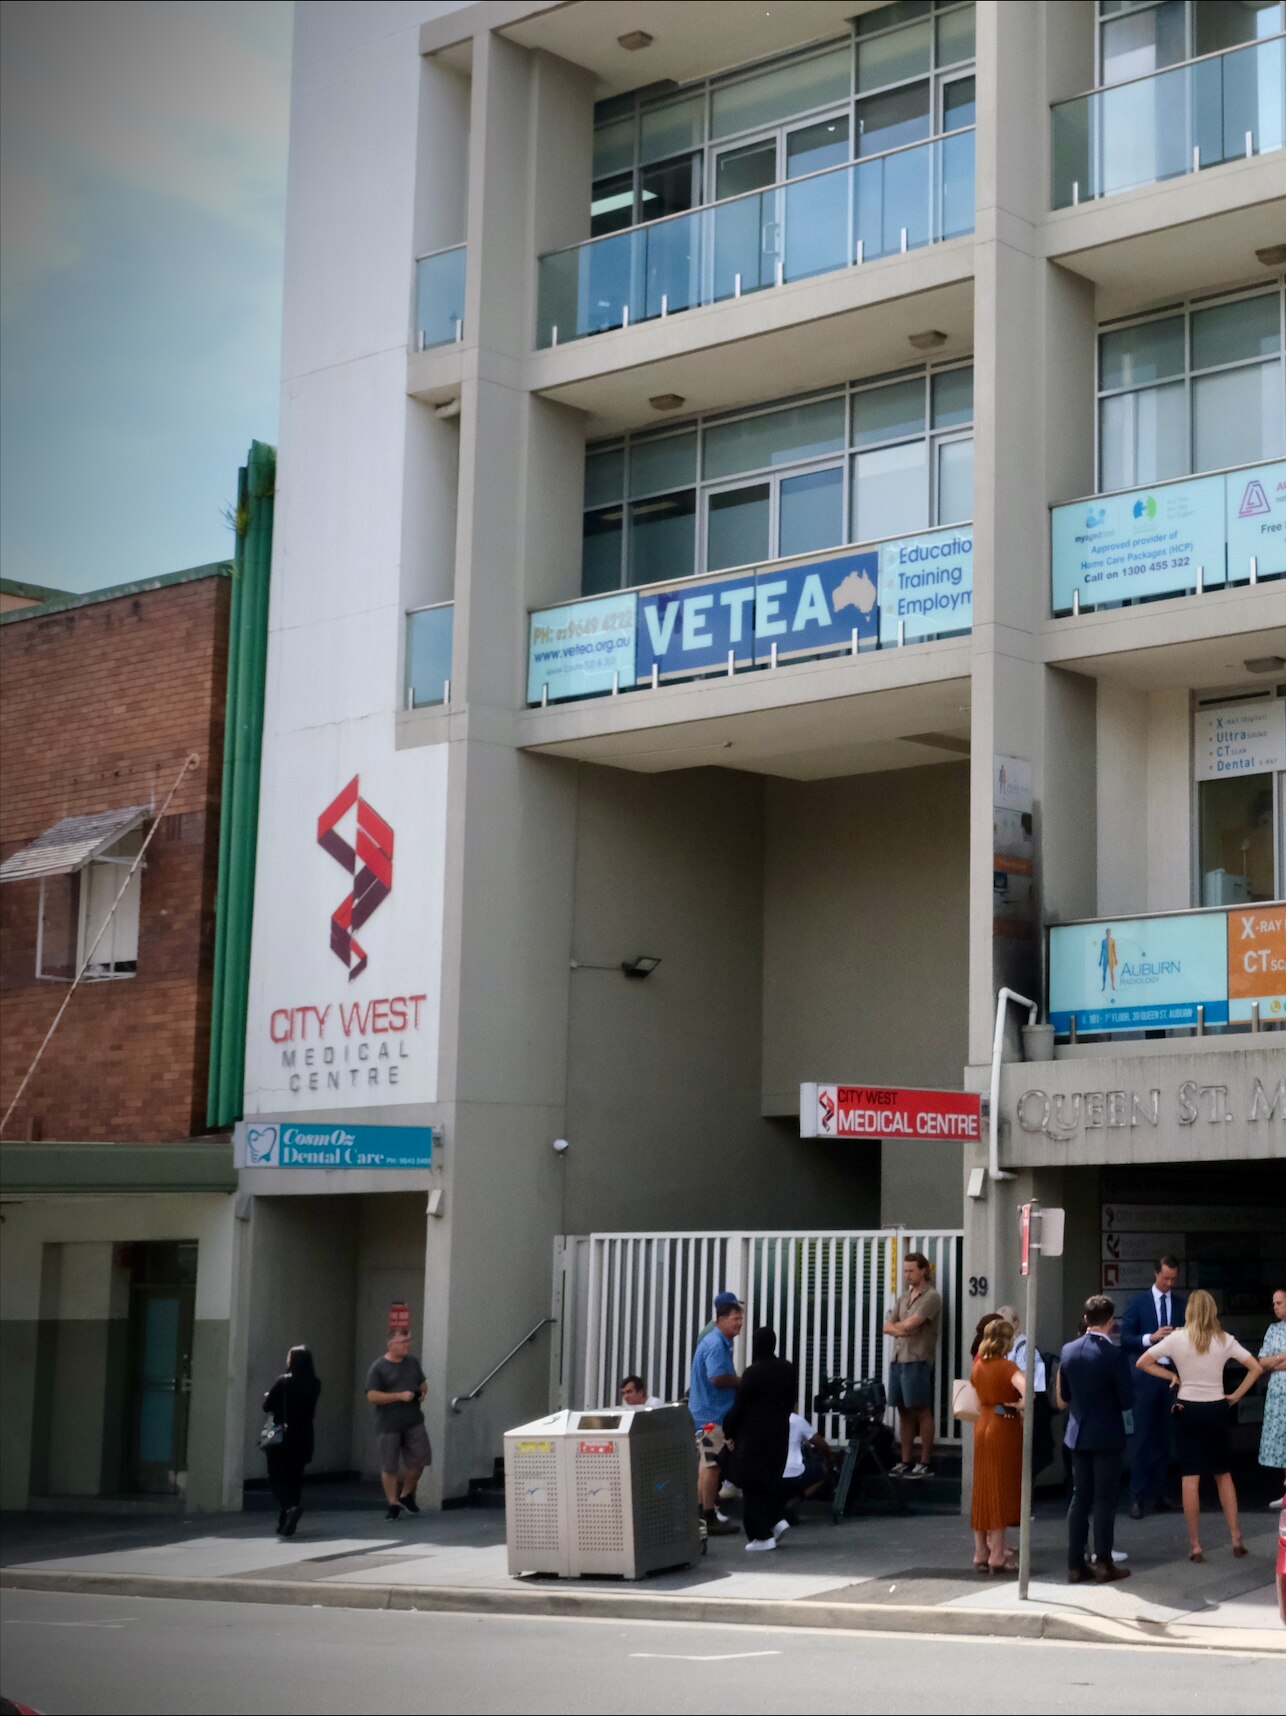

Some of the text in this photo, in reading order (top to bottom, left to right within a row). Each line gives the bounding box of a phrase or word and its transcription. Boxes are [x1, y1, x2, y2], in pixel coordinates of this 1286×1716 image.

[1261, 523, 1282, 534] Free
[899, 537, 972, 565] Educatio
[1091, 530, 1178, 555] Approved provider of
[1080, 542, 1194, 570] Home Care Packages (HCP)
[898, 566, 962, 590] Training
[1084, 556, 1190, 583] Call on 1300 455 322
[643, 573, 833, 657] VETEA
[534, 637, 630, 663] www.vetea.org.au
[1217, 756, 1255, 772] Dental
[1241, 916, 1282, 940] X-RAY
[1121, 961, 1181, 977] AUBURN
[270, 994, 427, 1044] CITY WEST
[1139, 1010, 1160, 1020] QUEEN
[1169, 1008, 1193, 1018] AUBURN
[281, 1040, 409, 1068] MEDICAL
[289, 1065, 399, 1093] CENTRE
[837, 1088, 898, 1106] CITY WEST
[1017, 1087, 1161, 1141] QUEEN
[1178, 1079, 1234, 1127] ST.
[838, 1110, 978, 1136] MEDICAL CENTRE
[282, 1128, 356, 1147] CosmOz
[283, 1147, 341, 1164] Dental
[344, 1148, 385, 1165] Care
[969, 1275, 989, 1298] 39
